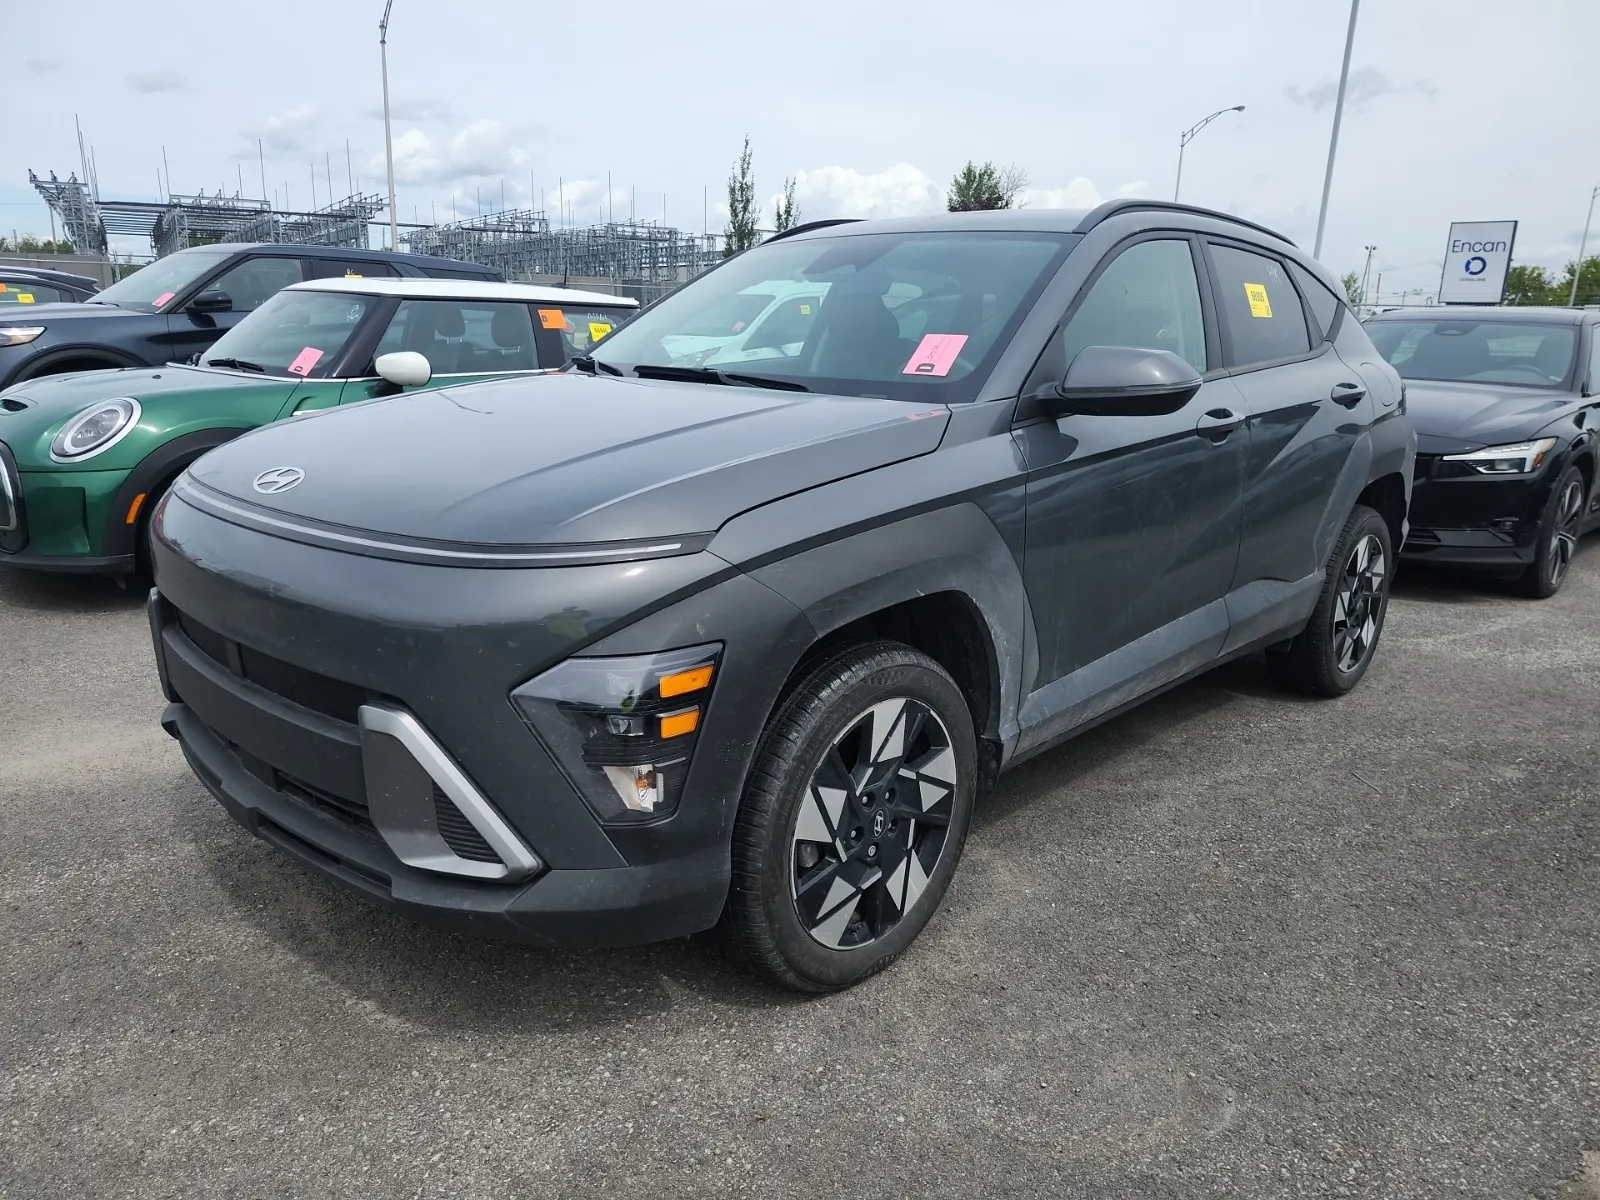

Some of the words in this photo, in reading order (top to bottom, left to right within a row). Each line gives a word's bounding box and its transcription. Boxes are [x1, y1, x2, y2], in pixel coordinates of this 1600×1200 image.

[1451, 239, 1506, 253] Encan
[541, 315, 548, 323] B
[915, 362, 936, 373] D
[788, 942, 838, 982] KUMHO
